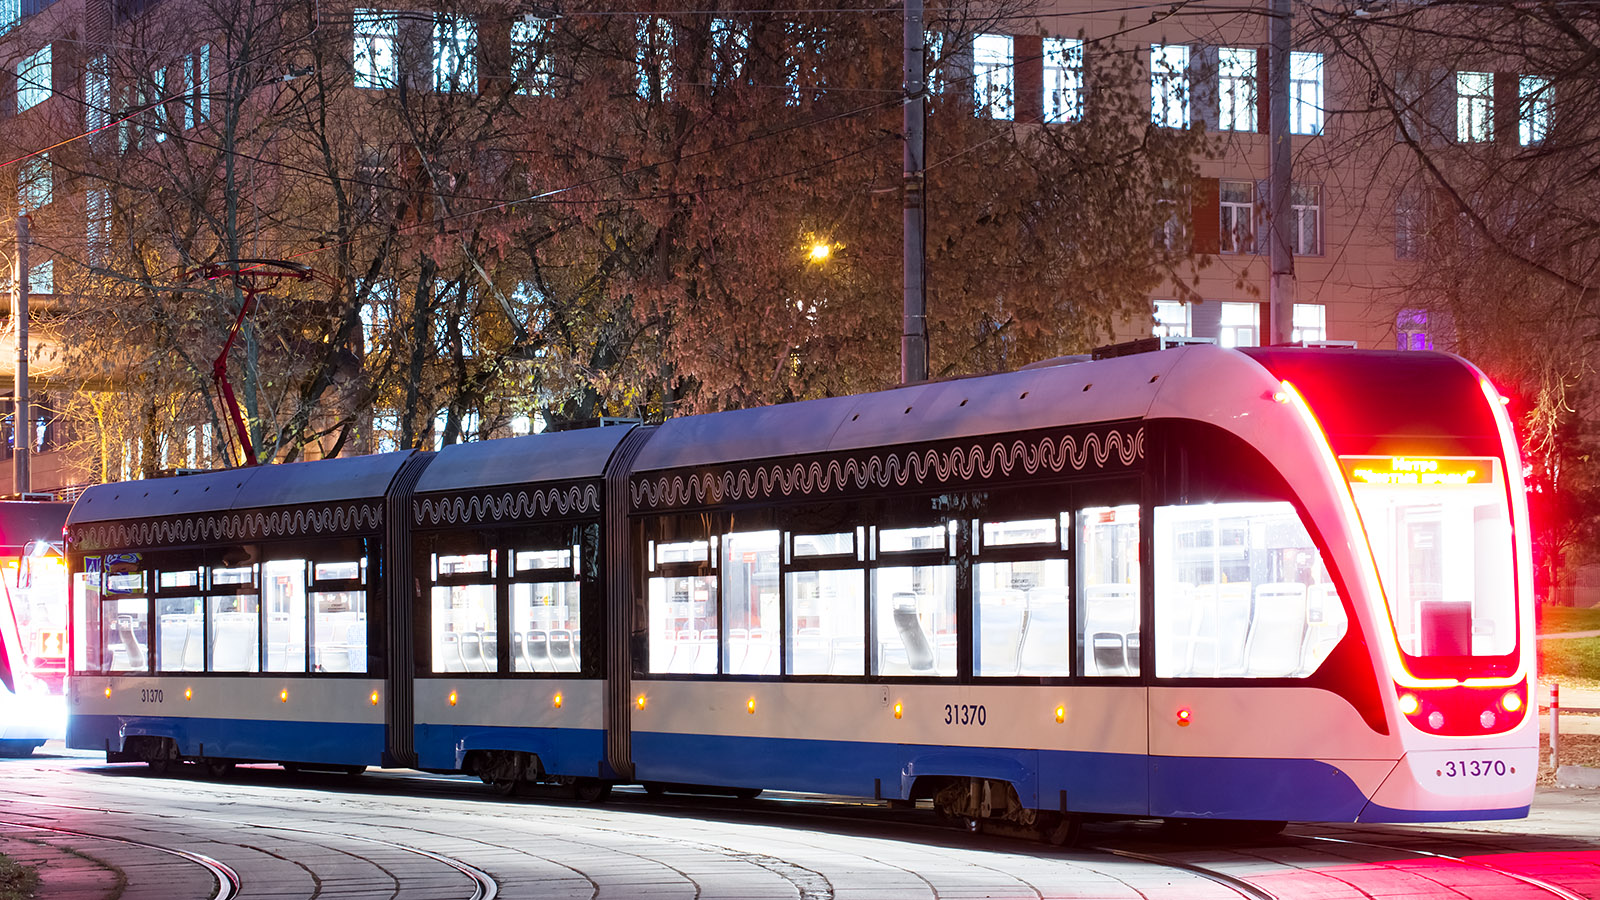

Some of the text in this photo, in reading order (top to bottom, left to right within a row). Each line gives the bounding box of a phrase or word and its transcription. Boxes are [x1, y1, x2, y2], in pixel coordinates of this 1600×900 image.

[141, 688, 164, 703] 31370
[944, 704, 987, 726] 31370
[1445, 760, 1506, 778] 31370
